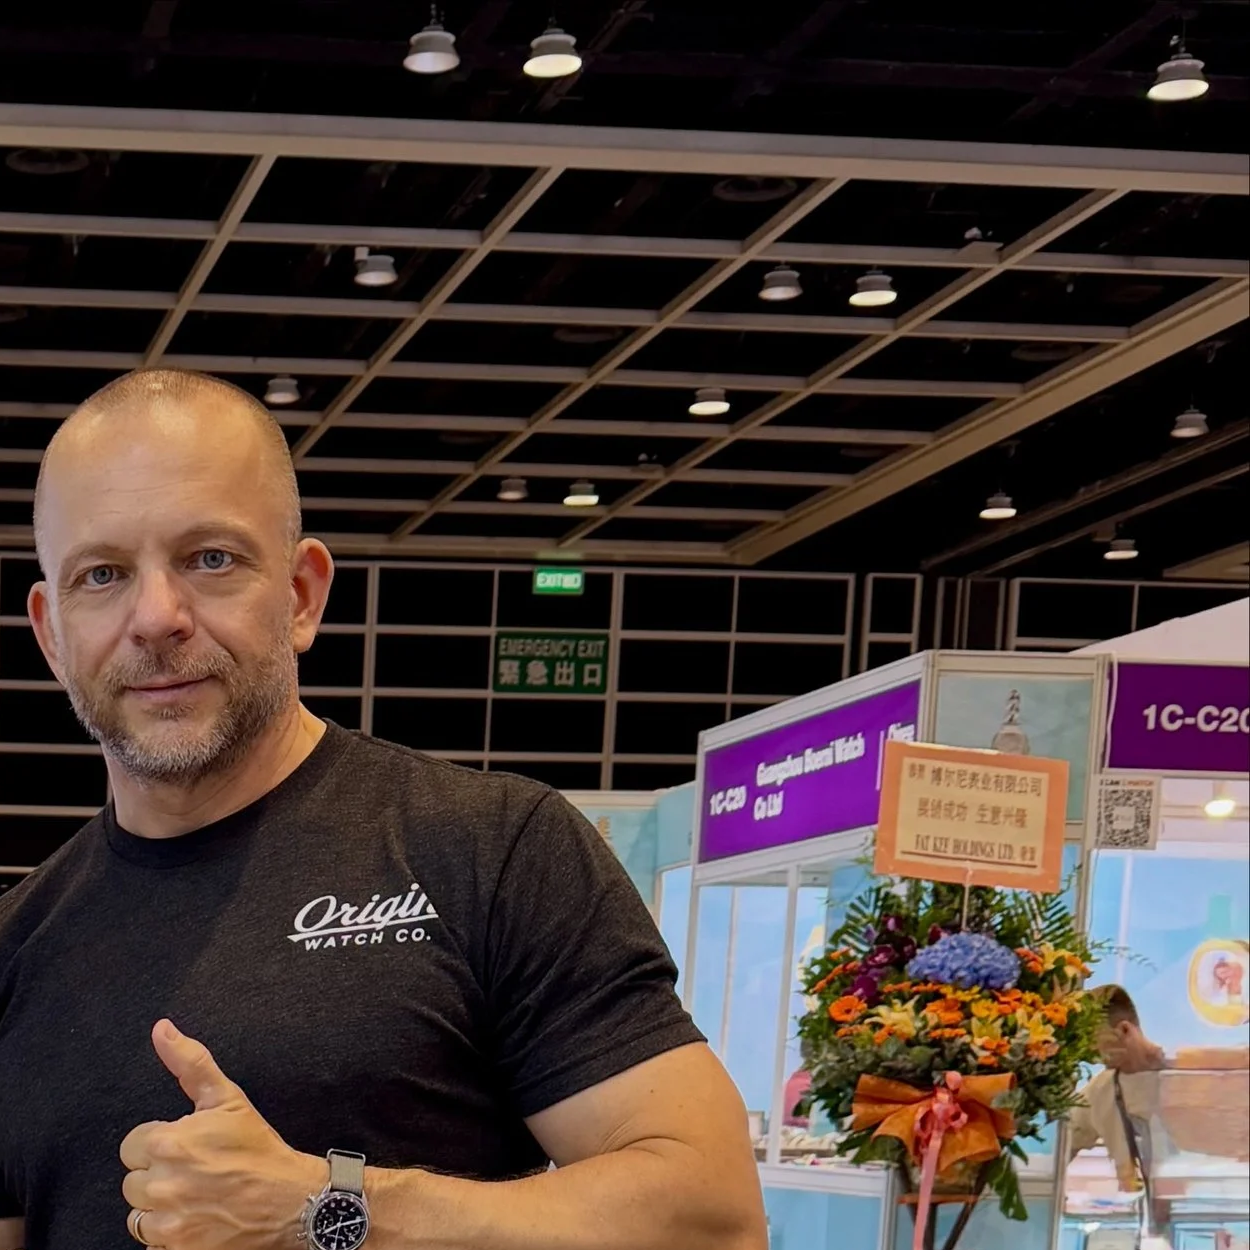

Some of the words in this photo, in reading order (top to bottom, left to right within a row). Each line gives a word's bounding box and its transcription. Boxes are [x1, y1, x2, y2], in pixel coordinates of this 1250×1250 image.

[499, 638, 576, 656] EMERGENCY
[578, 640, 605, 658] EXIT
[834, 733, 866, 763] Watch
[710, 786, 747, 816] 1C-C20
[305, 931, 384, 951] WATCH
[395, 927, 432, 943] CO.
